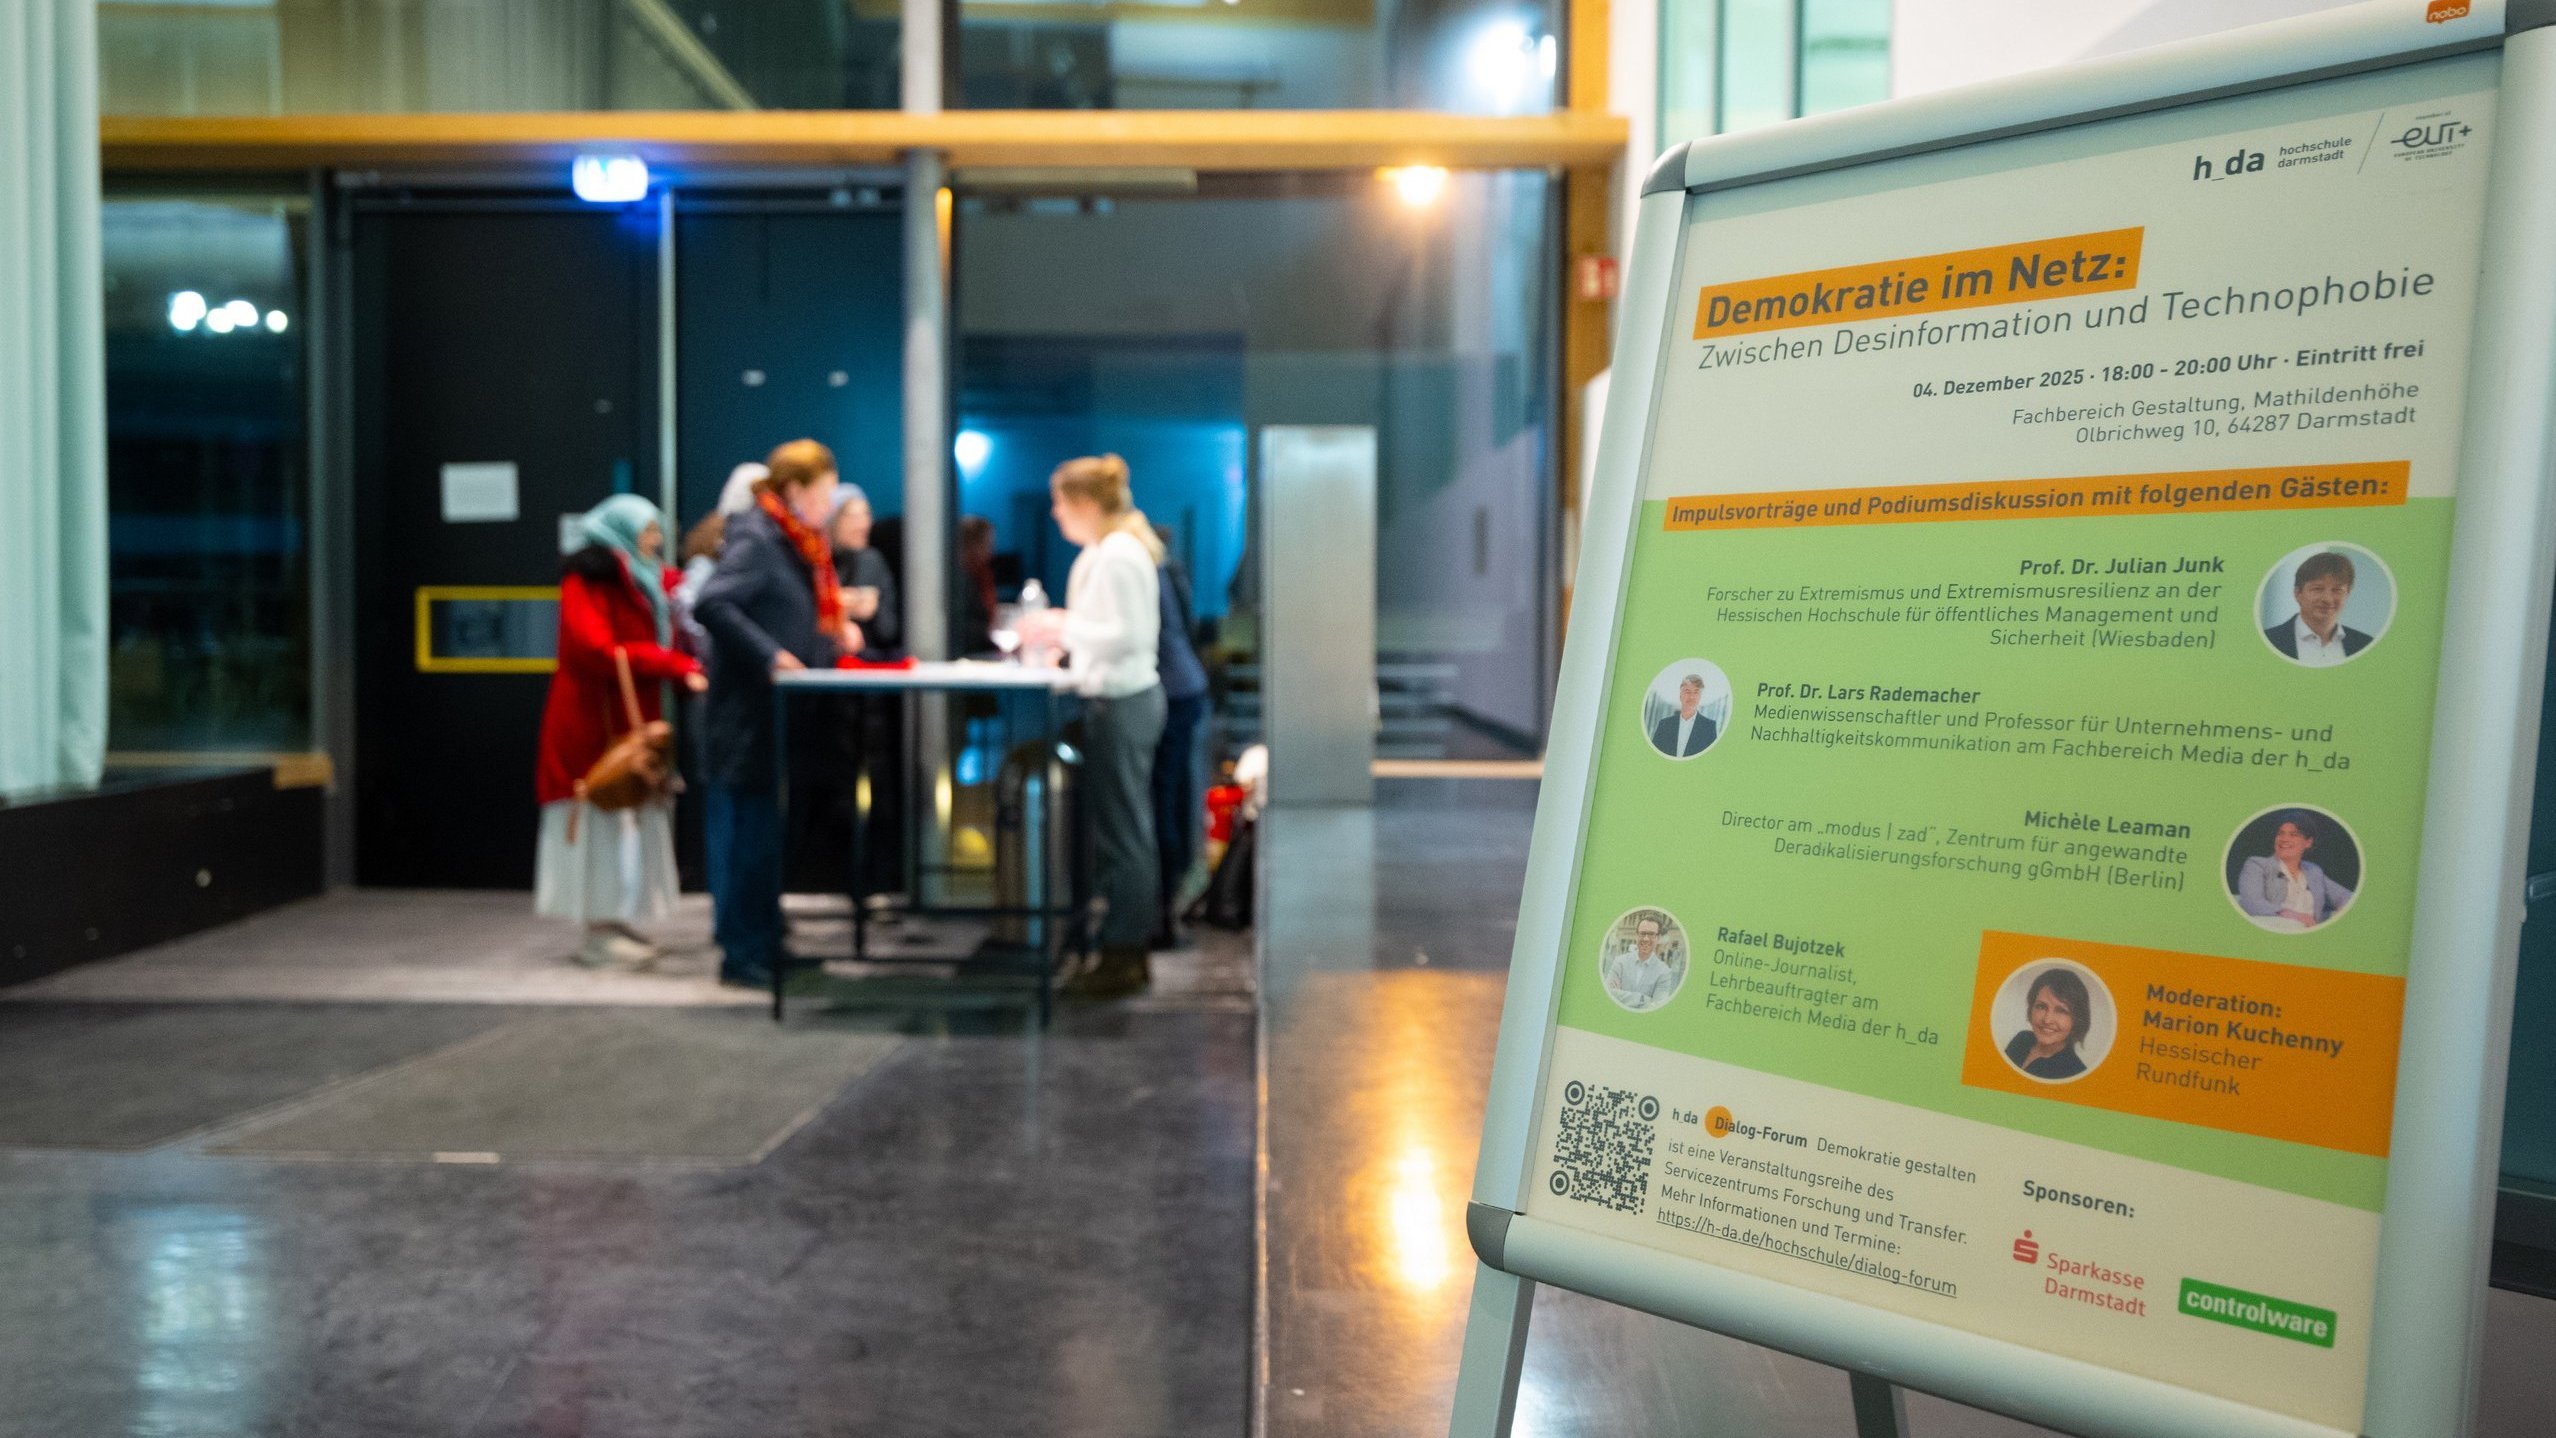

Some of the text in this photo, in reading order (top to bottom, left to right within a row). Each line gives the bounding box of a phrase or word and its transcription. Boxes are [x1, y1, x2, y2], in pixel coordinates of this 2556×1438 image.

[2193, 149, 2265, 181] h_da
[2277, 149, 2344, 168] darmstadt
[2279, 136, 2352, 157] hochschule
[1707, 250, 2126, 328] Demokratie im Netz:
[1698, 270, 2434, 369] Zwischen Desinformation und Technophobie
[1913, 382, 1937, 398] 04.
[1943, 376, 2035, 395] Dezember
[2039, 369, 2084, 387] 2025
[2102, 363, 2154, 382] 18:00
[2174, 356, 2231, 376] 20:00
[2237, 354, 2278, 371] Uhr
[2296, 345, 2377, 367] Eintritt
[2384, 339, 2424, 360] frei
[2013, 382, 2419, 424] Fachbereich Gestaltung, Mathildenhöhe
[2076, 406, 2416, 443] Olbrichweg 10, 64287 Darmstadt
[1673, 476, 2388, 526] Impulsvorträge und Podiumsdiskussion mit folgenden Gästen:
[2020, 556, 2224, 575] Prof. Dr. Julian Junk
[1707, 581, 2222, 601] Forscher zu Extremismus und Extremismusresilienz an der
[1717, 606, 2219, 627] Hessischen Hochschule für öffentliches Management und
[1990, 628, 2216, 649] Sicherheit (Wiesbaden)
[1757, 682, 1981, 704] Prof. Dr. Lars Rademacher
[1754, 704, 2333, 742] Medienwissenschaftler und Professor für Unternehmens- und
[1751, 725, 2350, 773] Nachhaltigkeitskommunikation am Fachbereich Media der h_da
[1722, 810, 1784, 830] Director
[1787, 820, 1812, 832] am
[1946, 828, 2025, 850] Zentrum
[2031, 835, 2059, 853] für
[2064, 842, 2188, 864] angewandte
[2024, 810, 2190, 839] Michèle Leaman
[1774, 837, 2184, 892] Deradikalisierungsforschung gGmbH (Berlin)
[1717, 927, 1845, 958] Rafael Bujotzek
[1713, 949, 1856, 985] Online-Journalist,
[1710, 971, 1878, 1010] Lehrbeauftragter am
[2146, 983, 2281, 1018] Moderation:
[1706, 993, 1938, 1045] Fachbereich Media der h_da
[2143, 1010, 2344, 1059] Marion Kuchenny
[2139, 1036, 2262, 1070] Hessischer
[2136, 1061, 2240, 1096] Rundfunk
[1672, 1108, 1976, 1183] h_da Dialog-Forum Demokratie gestalten
[1668, 1139, 1894, 1201] ist eine Veranstaltungsreihe des
[1665, 1161, 1967, 1244] Servicezentrums Forschung und Transfer.
[2022, 1179, 2135, 1218] Sponsoren:
[1661, 1184, 1900, 1255] Mehr Informationen und Termine:
[1657, 1208, 1957, 1296] https://h-da.de/hochschule/dialog-forum
[2047, 1252, 2146, 1290] Sparkasse
[2044, 1277, 2147, 1317] Darmstadt
[2185, 1289, 2329, 1338] controlware
